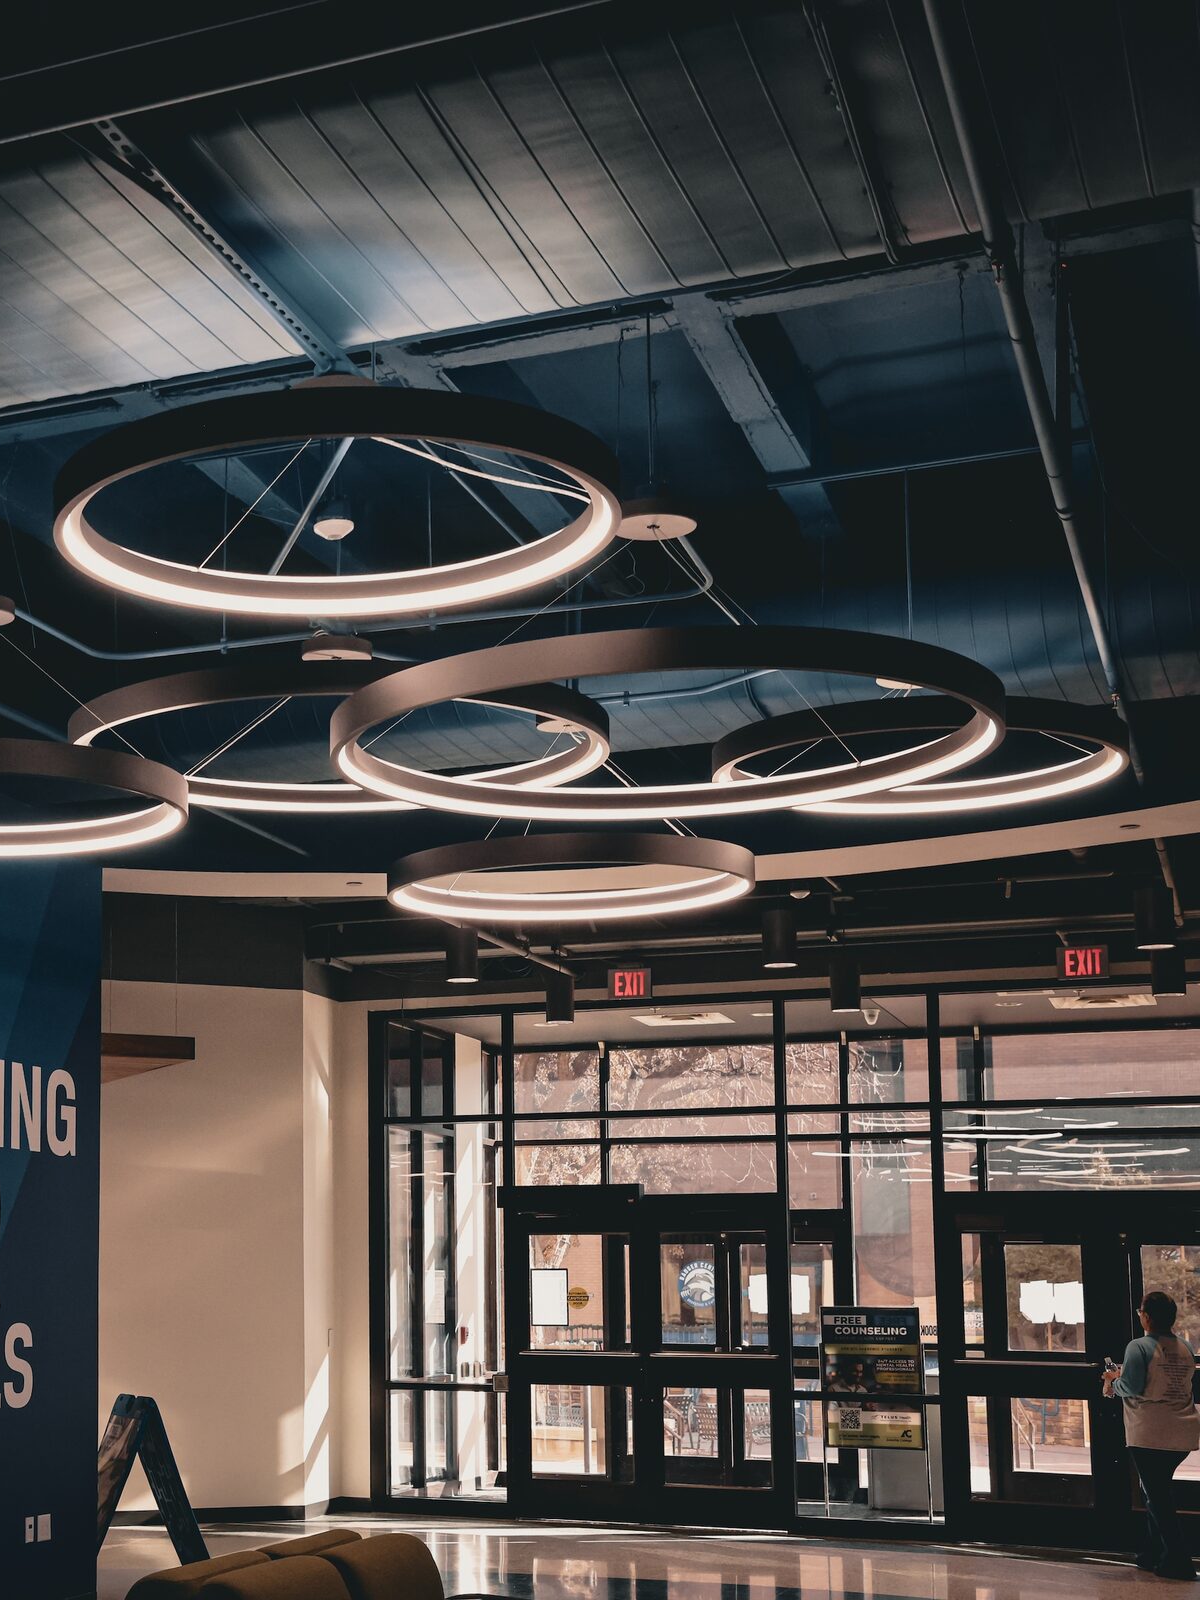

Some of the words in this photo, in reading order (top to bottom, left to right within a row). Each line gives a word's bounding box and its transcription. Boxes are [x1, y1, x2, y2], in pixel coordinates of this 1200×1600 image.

[1064, 948, 1104, 977] EXIT
[614, 971, 646, 997] EXIT
[834, 1316, 862, 1325] FREE
[834, 1326, 908, 1336] COUNSELING
